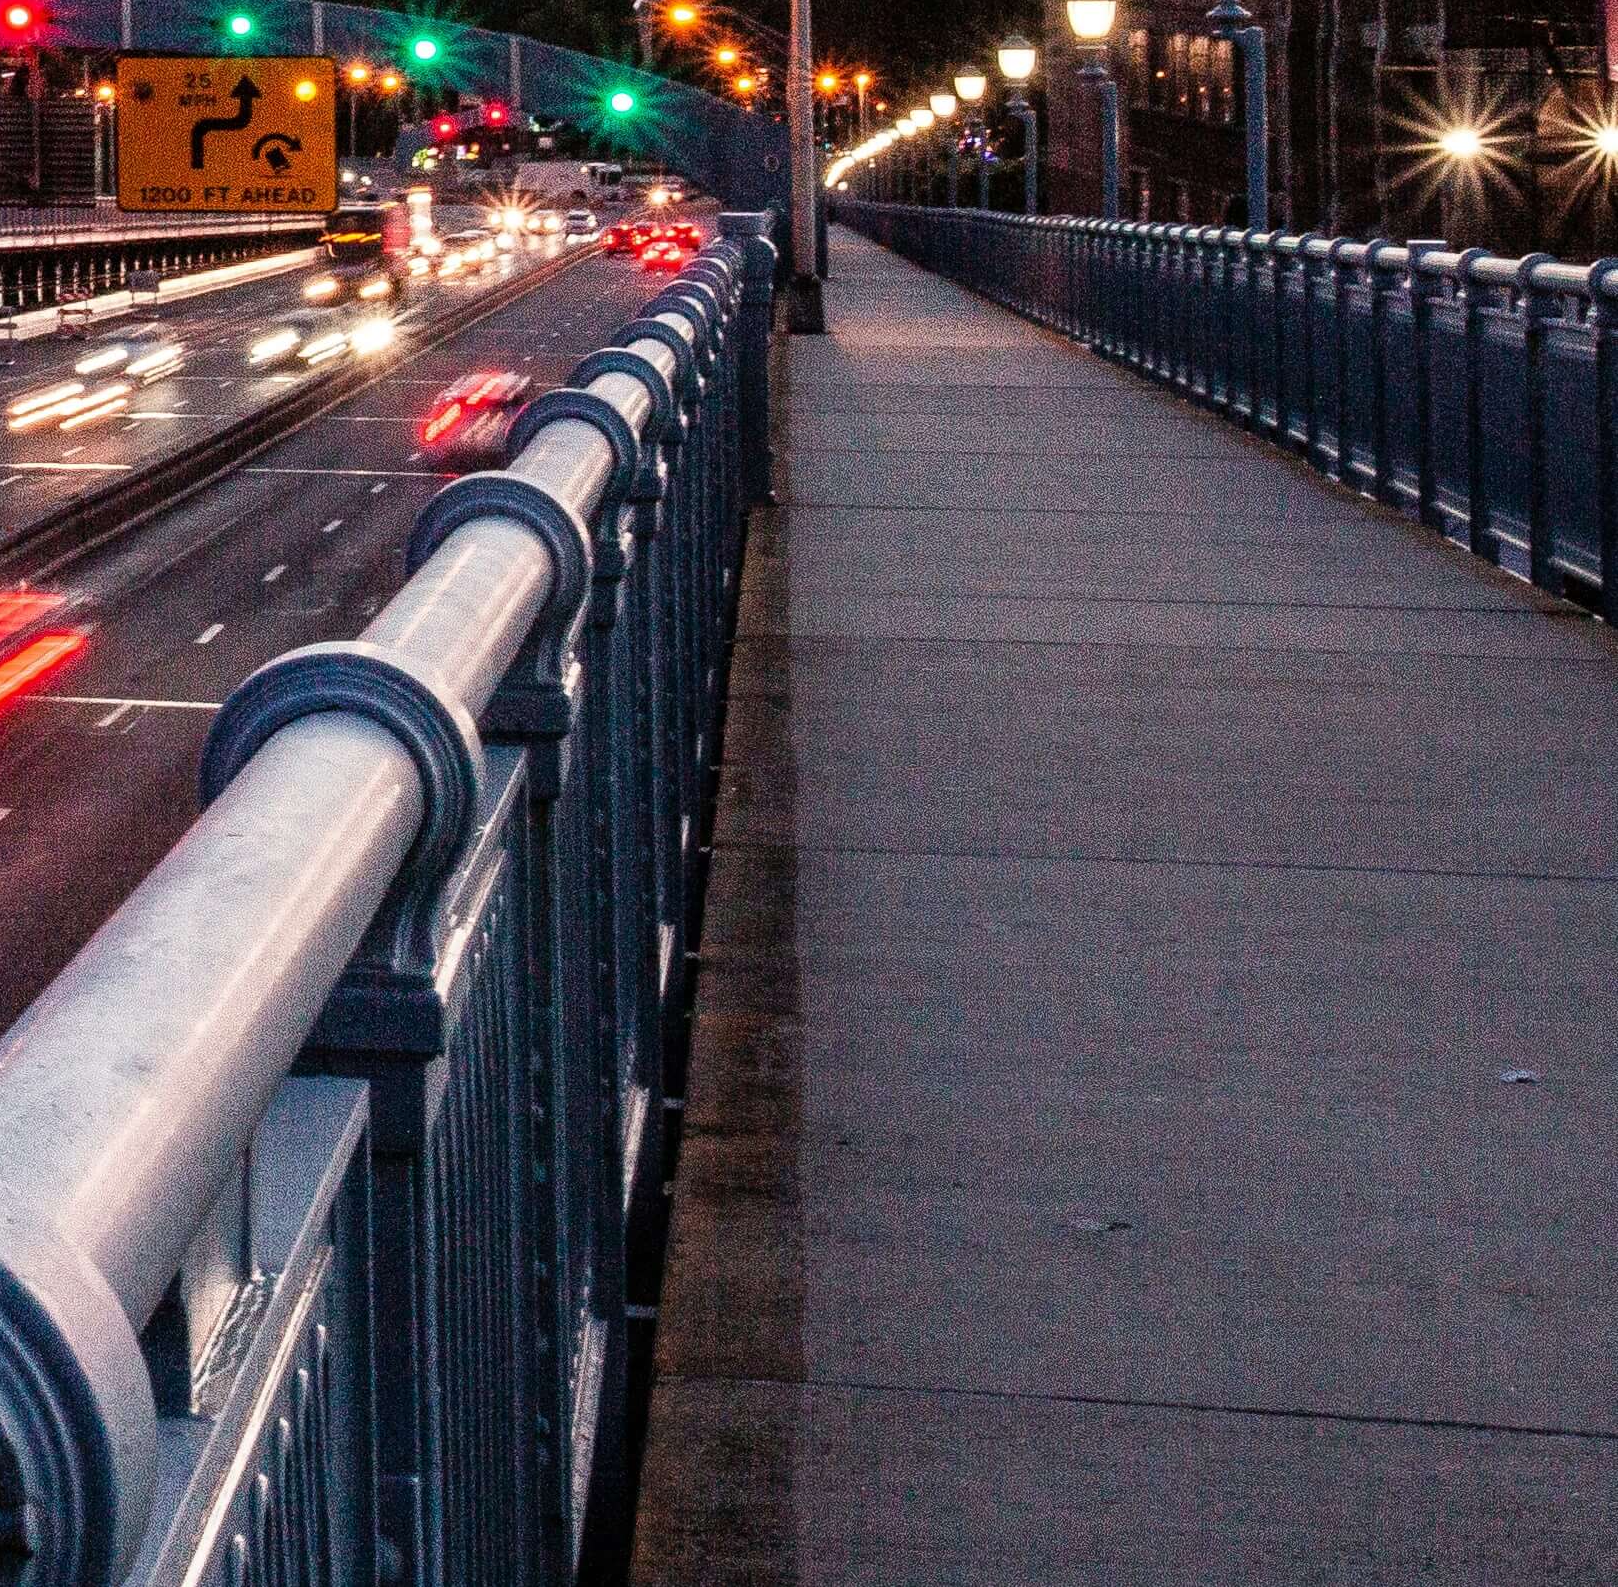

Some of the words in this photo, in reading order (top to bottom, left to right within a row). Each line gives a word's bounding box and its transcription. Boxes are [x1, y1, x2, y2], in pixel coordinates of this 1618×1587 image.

[140, 187, 191, 203] 1200
[203, 187, 230, 203] FT
[241, 187, 316, 203] AHEAD
